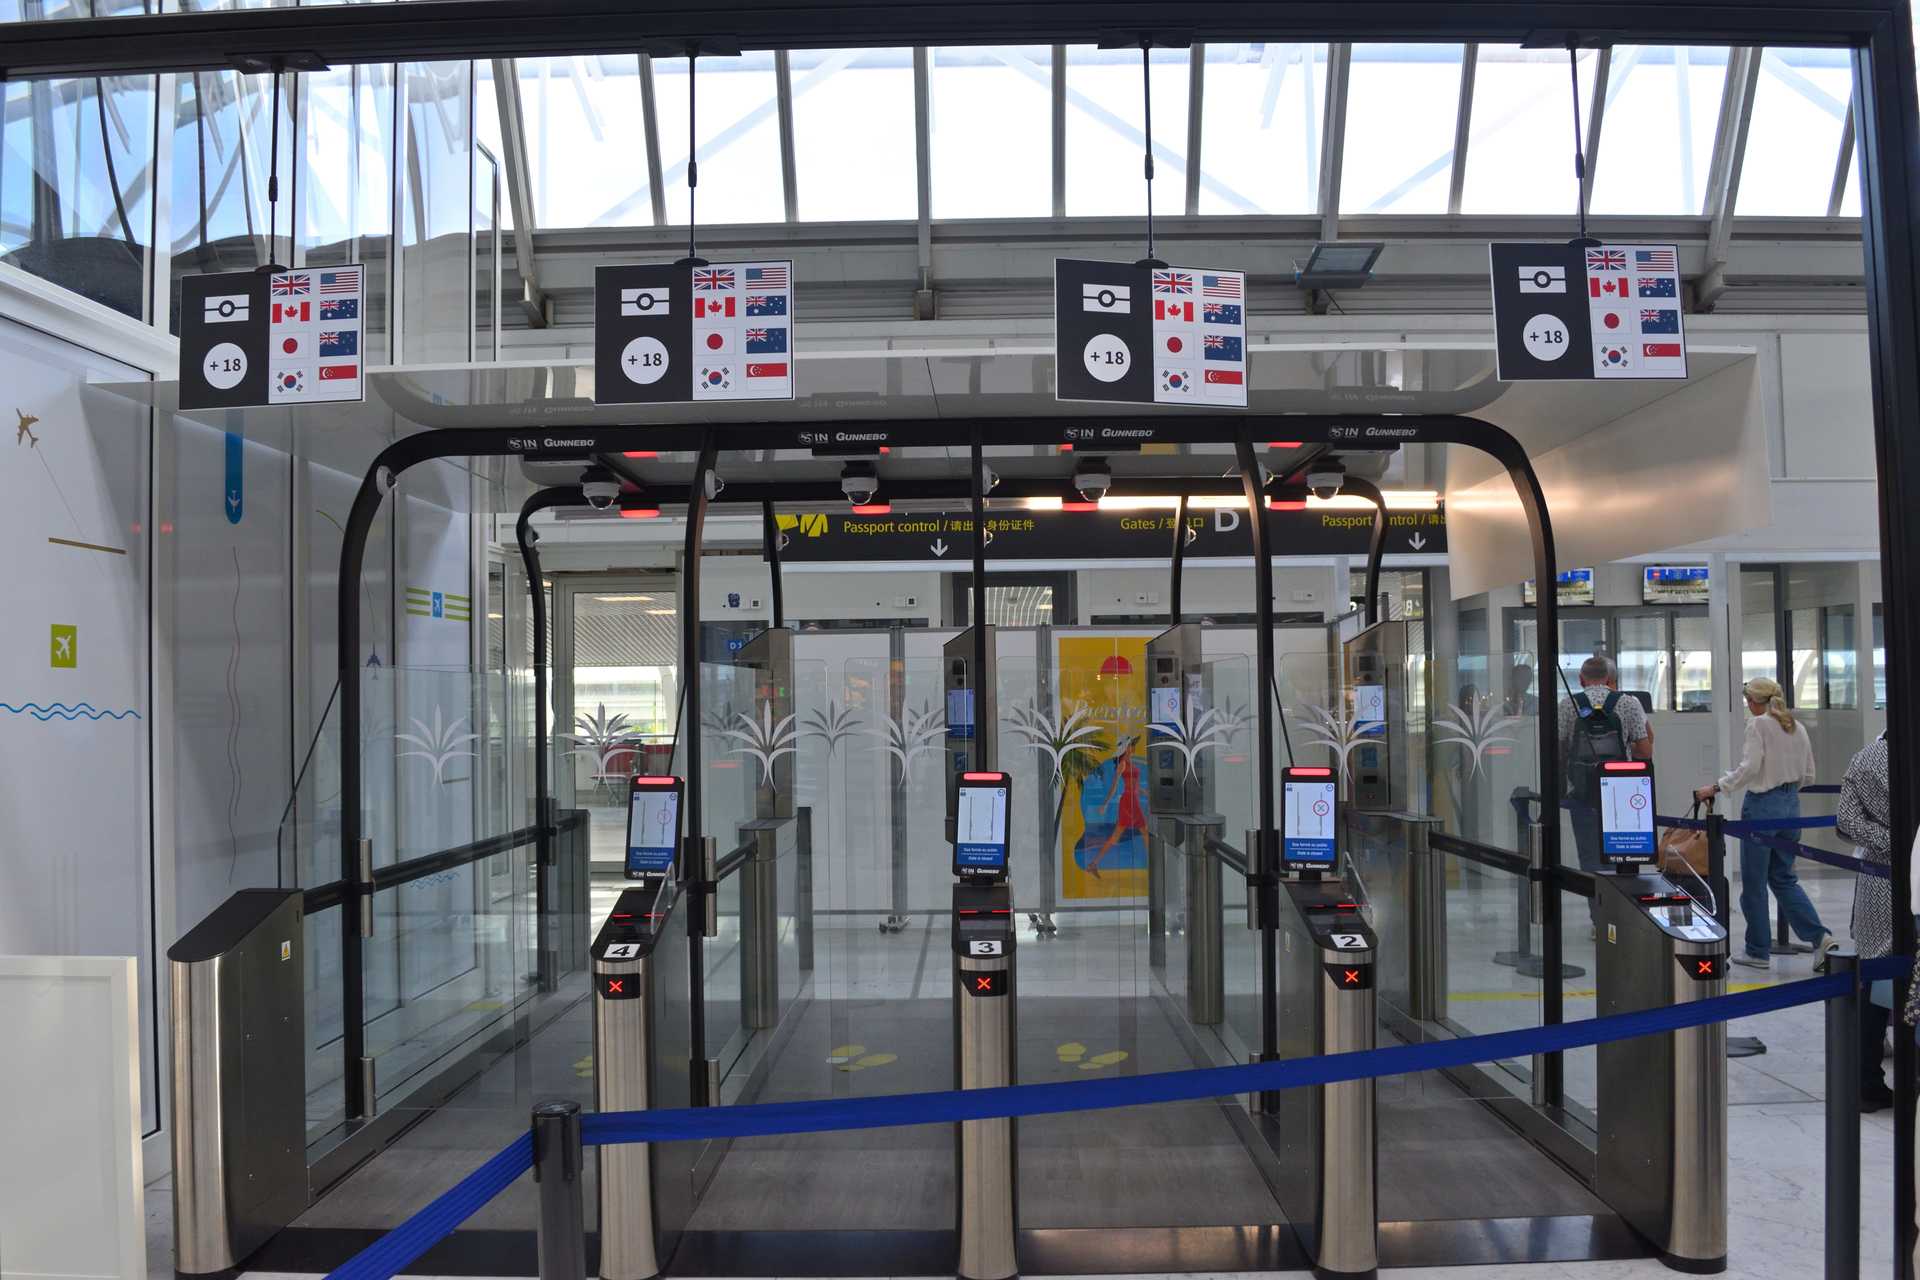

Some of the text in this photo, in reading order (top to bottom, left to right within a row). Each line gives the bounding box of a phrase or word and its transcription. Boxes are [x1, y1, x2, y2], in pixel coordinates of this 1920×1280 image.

[1544, 330, 1563, 344] 18
[643, 352, 662, 367] 18
[1105, 351, 1125, 365] 18
[223, 358, 242, 372] 18
[835, 432, 888, 441] GUNNEBO
[1101, 428, 1154, 438] GUNNEBO
[1365, 427, 1417, 437] GUNNEBO
[543, 438, 595, 448] GUNNEBO
[1120, 518, 1156, 530] Gates
[1214, 508, 1240, 532] D
[1322, 514, 1373, 529] Passport
[844, 520, 897, 536] Passport
[897, 519, 940, 533] control
[951, 519, 1035, 532] 请出身份证件
[1340, 935, 1361, 947] 2
[611, 945, 630, 956] 4
[978, 942, 994, 954] 3
